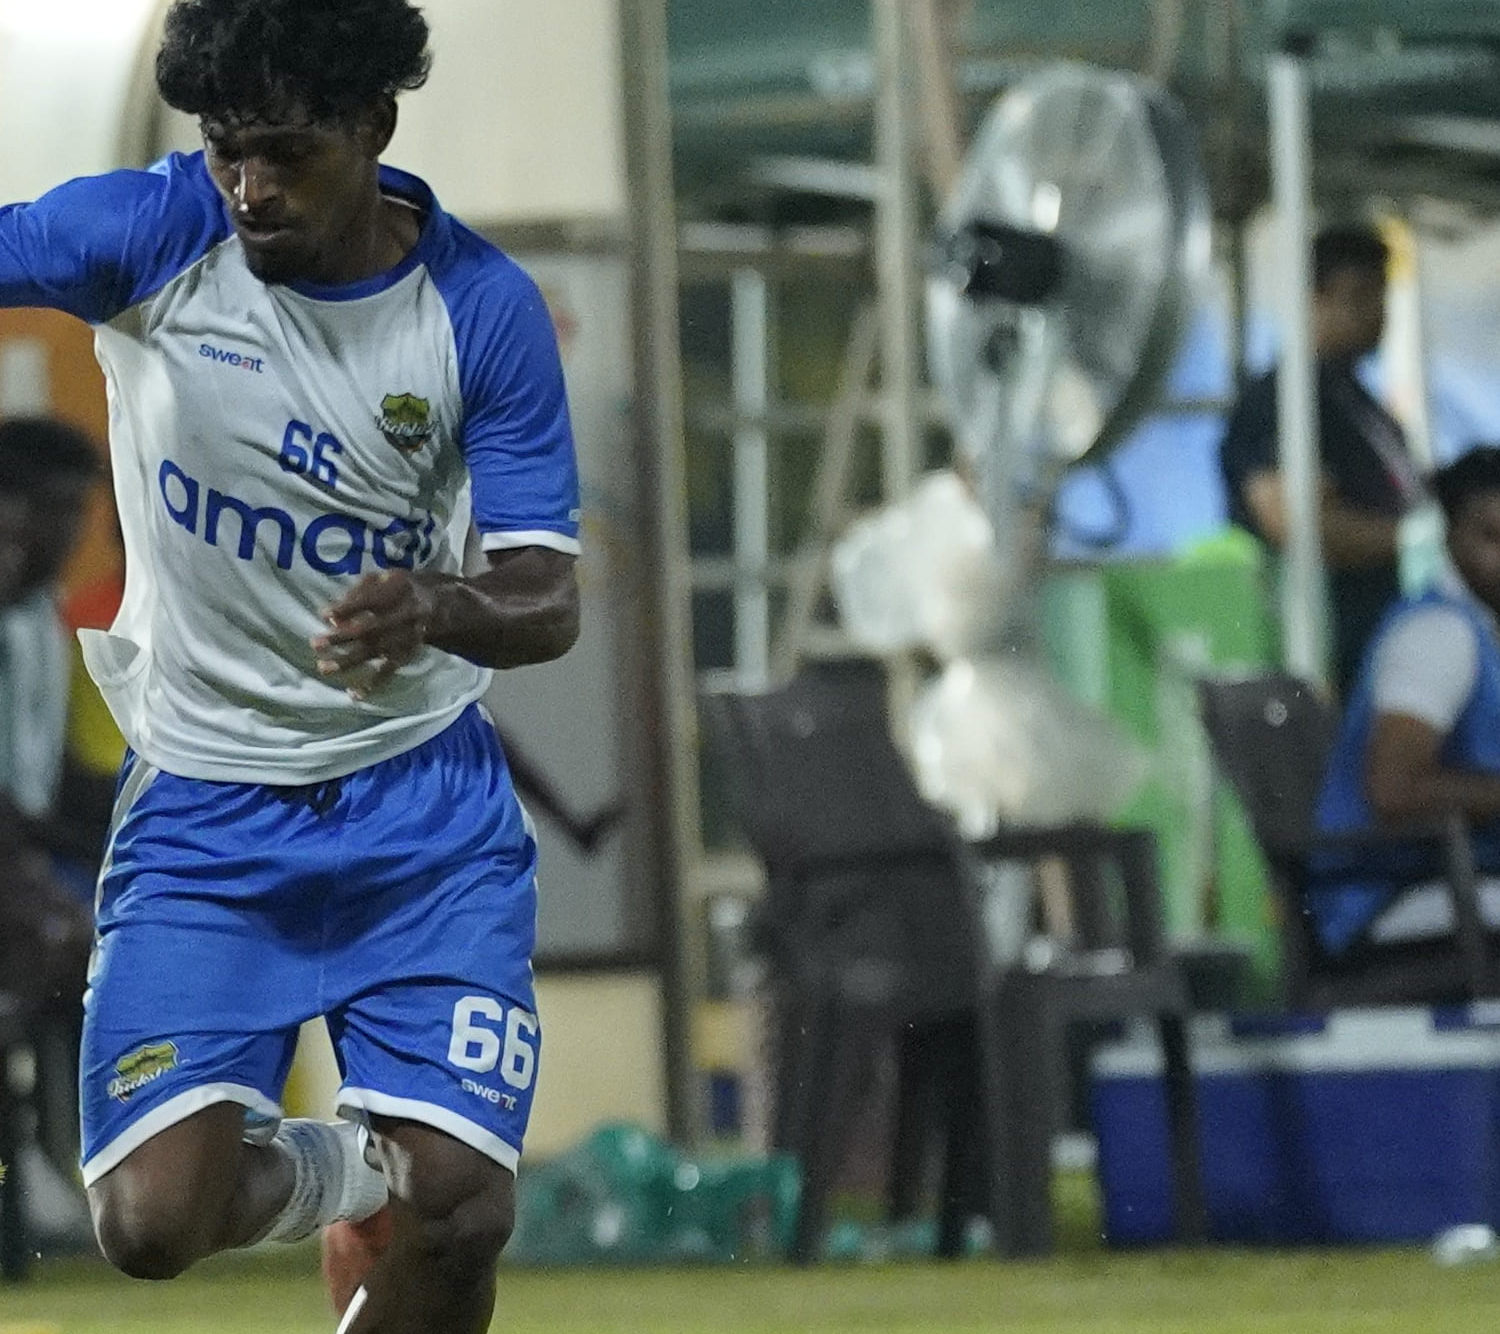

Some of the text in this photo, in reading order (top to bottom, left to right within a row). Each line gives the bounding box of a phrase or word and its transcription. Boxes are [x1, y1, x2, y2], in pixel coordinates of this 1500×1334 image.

[198, 343, 265, 374] sweat
[278, 418, 343, 490] 66
[447, 994, 539, 1091] 66
